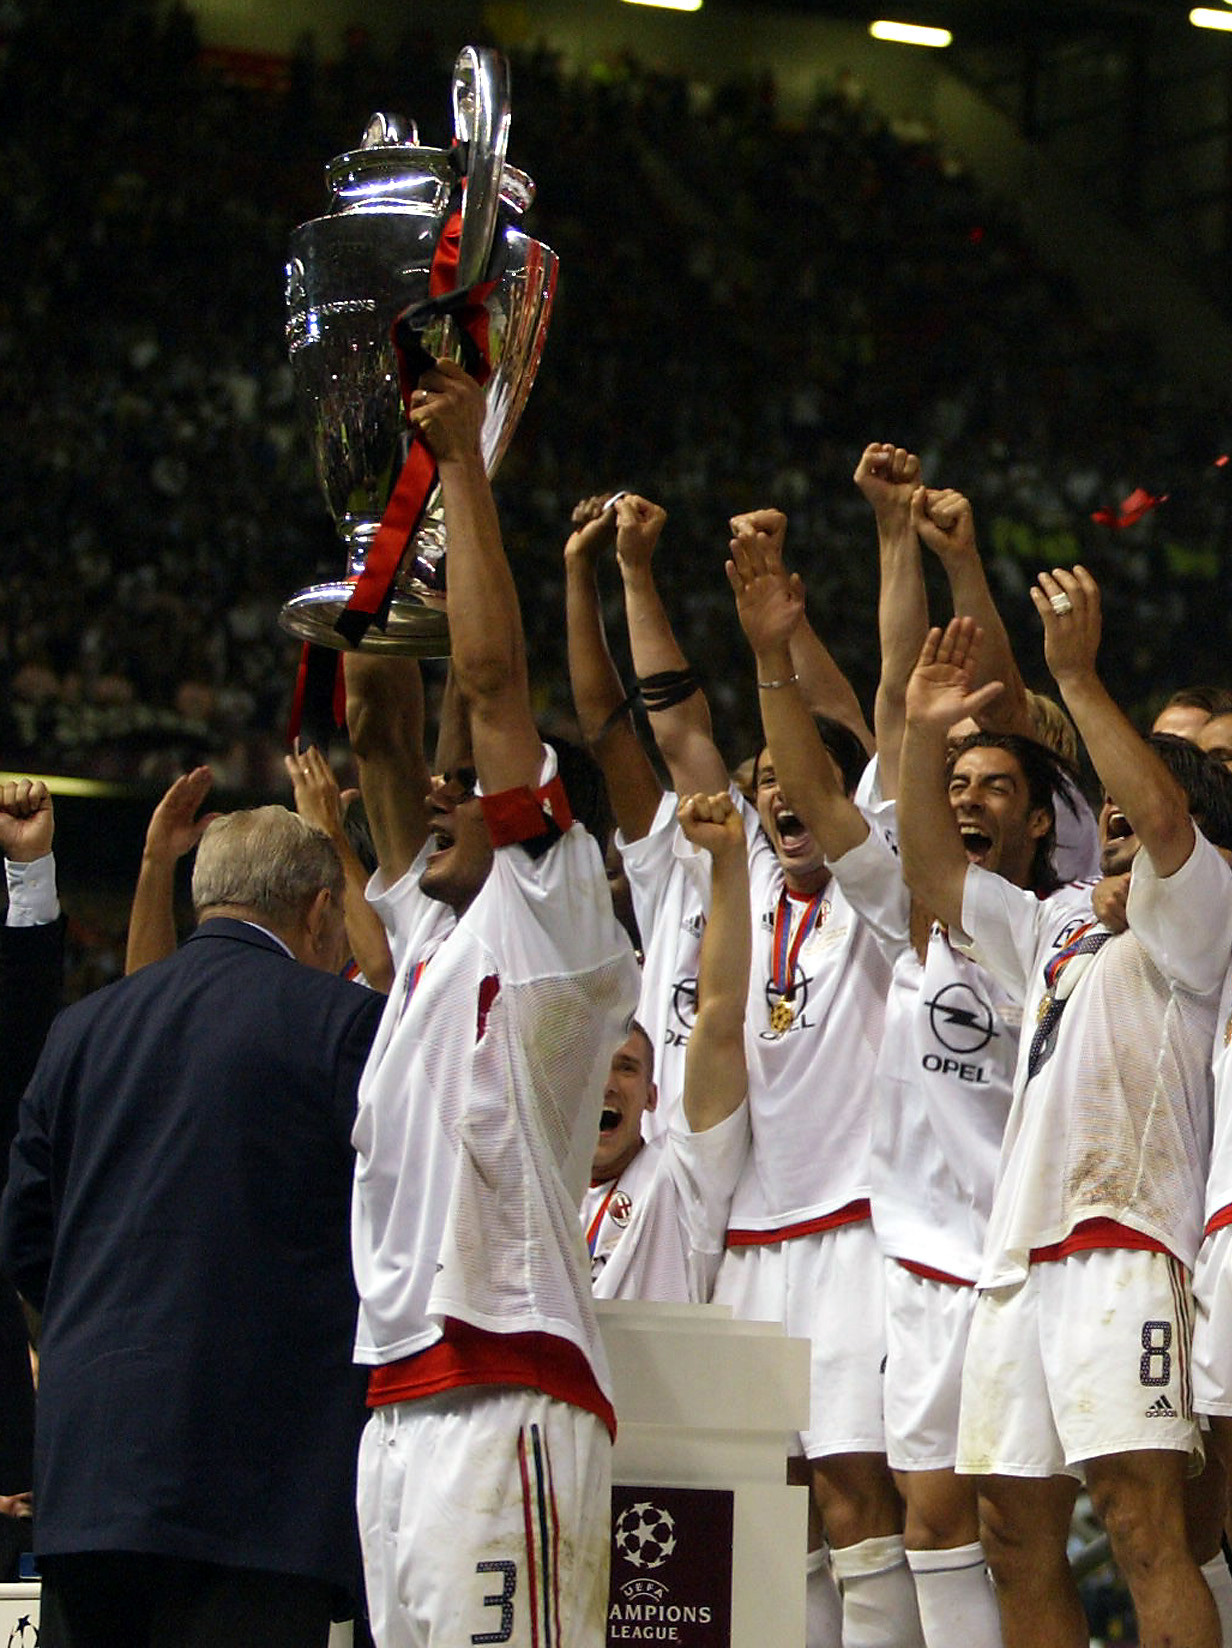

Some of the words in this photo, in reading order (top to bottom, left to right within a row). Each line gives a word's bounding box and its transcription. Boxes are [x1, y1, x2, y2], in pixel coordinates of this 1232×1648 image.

[922, 1054, 990, 1084] OPEL
[1140, 1321, 1172, 1387] 8
[471, 1560, 517, 1645] 3
[623, 1582, 664, 1599] UEFA
[608, 1603, 712, 1624] AMPIONS
[611, 1624, 679, 1641] LEAGUE
